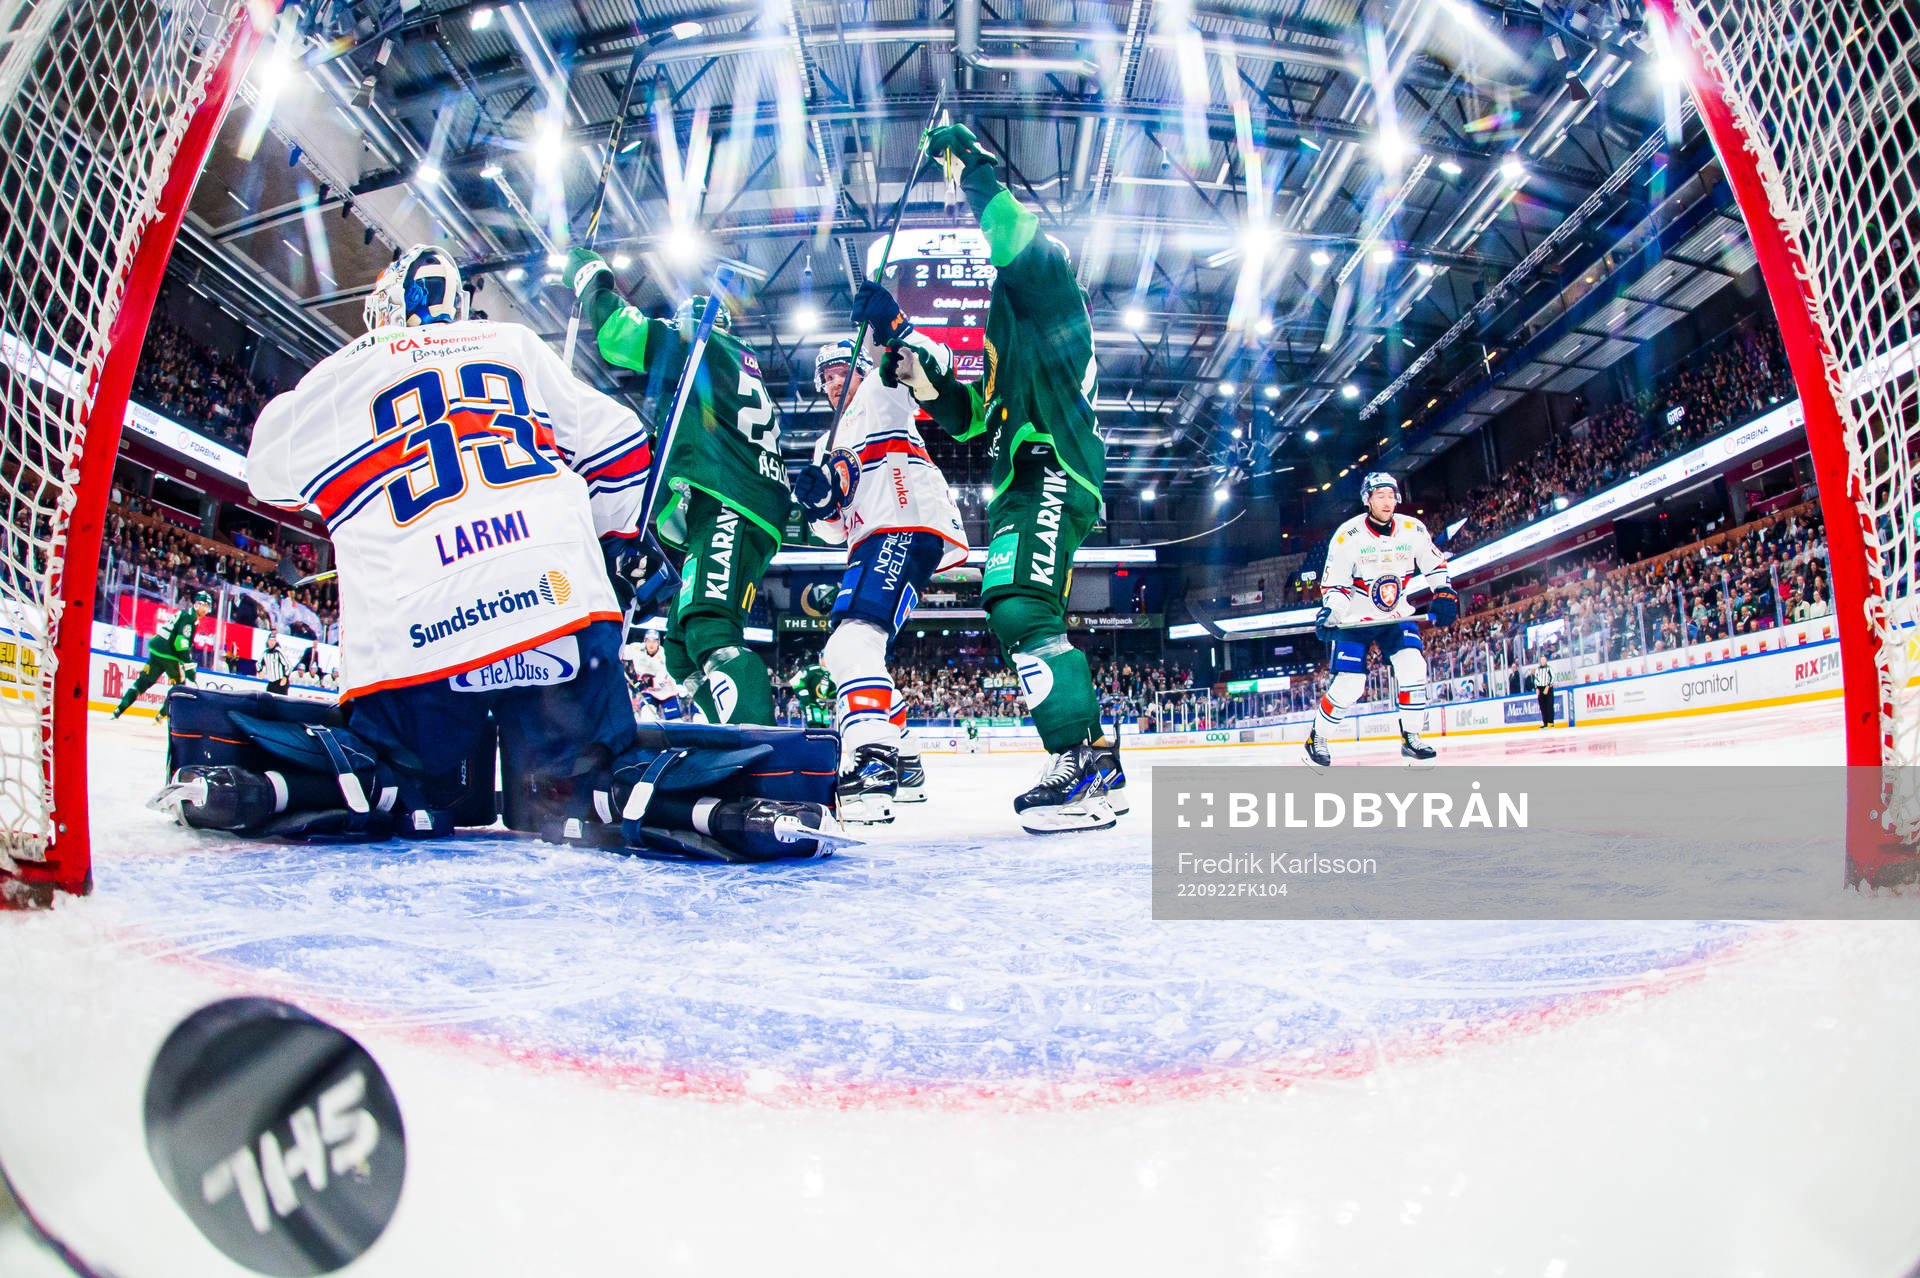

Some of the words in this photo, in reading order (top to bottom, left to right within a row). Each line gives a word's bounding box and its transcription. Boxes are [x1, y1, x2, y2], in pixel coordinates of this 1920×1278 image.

[390, 339, 420, 355] ICA
[423, 331, 497, 346] Supermarket
[411, 344, 481, 363] Borgholm
[369, 360, 561, 528] 33
[1736, 424, 1769, 447] FORBINA
[189, 440, 222, 462] FORBINA
[435, 510, 531, 567] LARMI
[409, 587, 540, 649] Sundström
[785, 619, 807, 628] THE
[1083, 617, 1098, 625] The
[1099, 617, 1133, 627] Wolfpack
[1795, 651, 1839, 681] RIXFM
[1586, 692, 1615, 708] MAXI
[1206, 732, 1230, 743] coop
